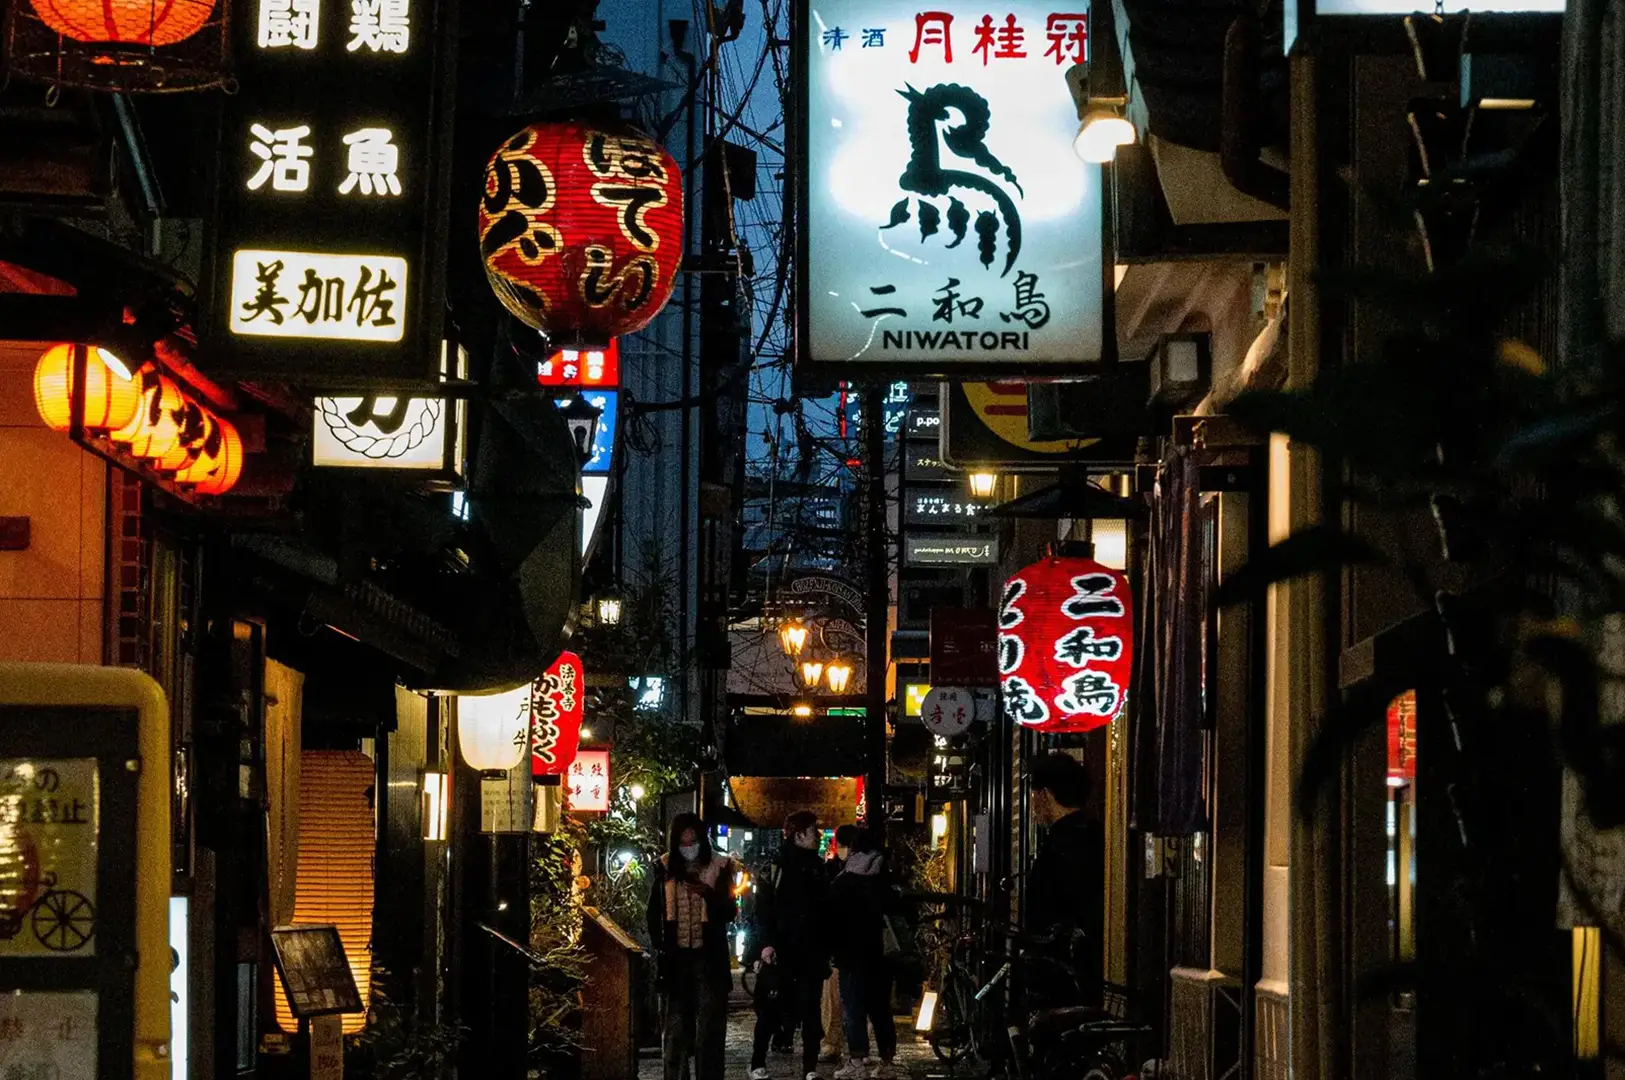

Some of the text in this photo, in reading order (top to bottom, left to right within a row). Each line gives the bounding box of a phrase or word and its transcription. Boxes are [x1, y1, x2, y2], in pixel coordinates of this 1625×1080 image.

[822, 26, 887, 50] 清酒
[908, 12, 1087, 66] 月桂冠
[247, 123, 402, 196] 活魚
[239, 260, 397, 328] 美加佐
[860, 270, 1050, 330] 二和鳥
[883, 330, 1028, 351] NIWATORI
[916, 458, 942, 467] スナッ
[916, 503, 988, 516] まんまる食
[1054, 573, 1125, 716] 二和鳥
[559, 664, 576, 711] 法善寺
[532, 672, 560, 764] かもふく
